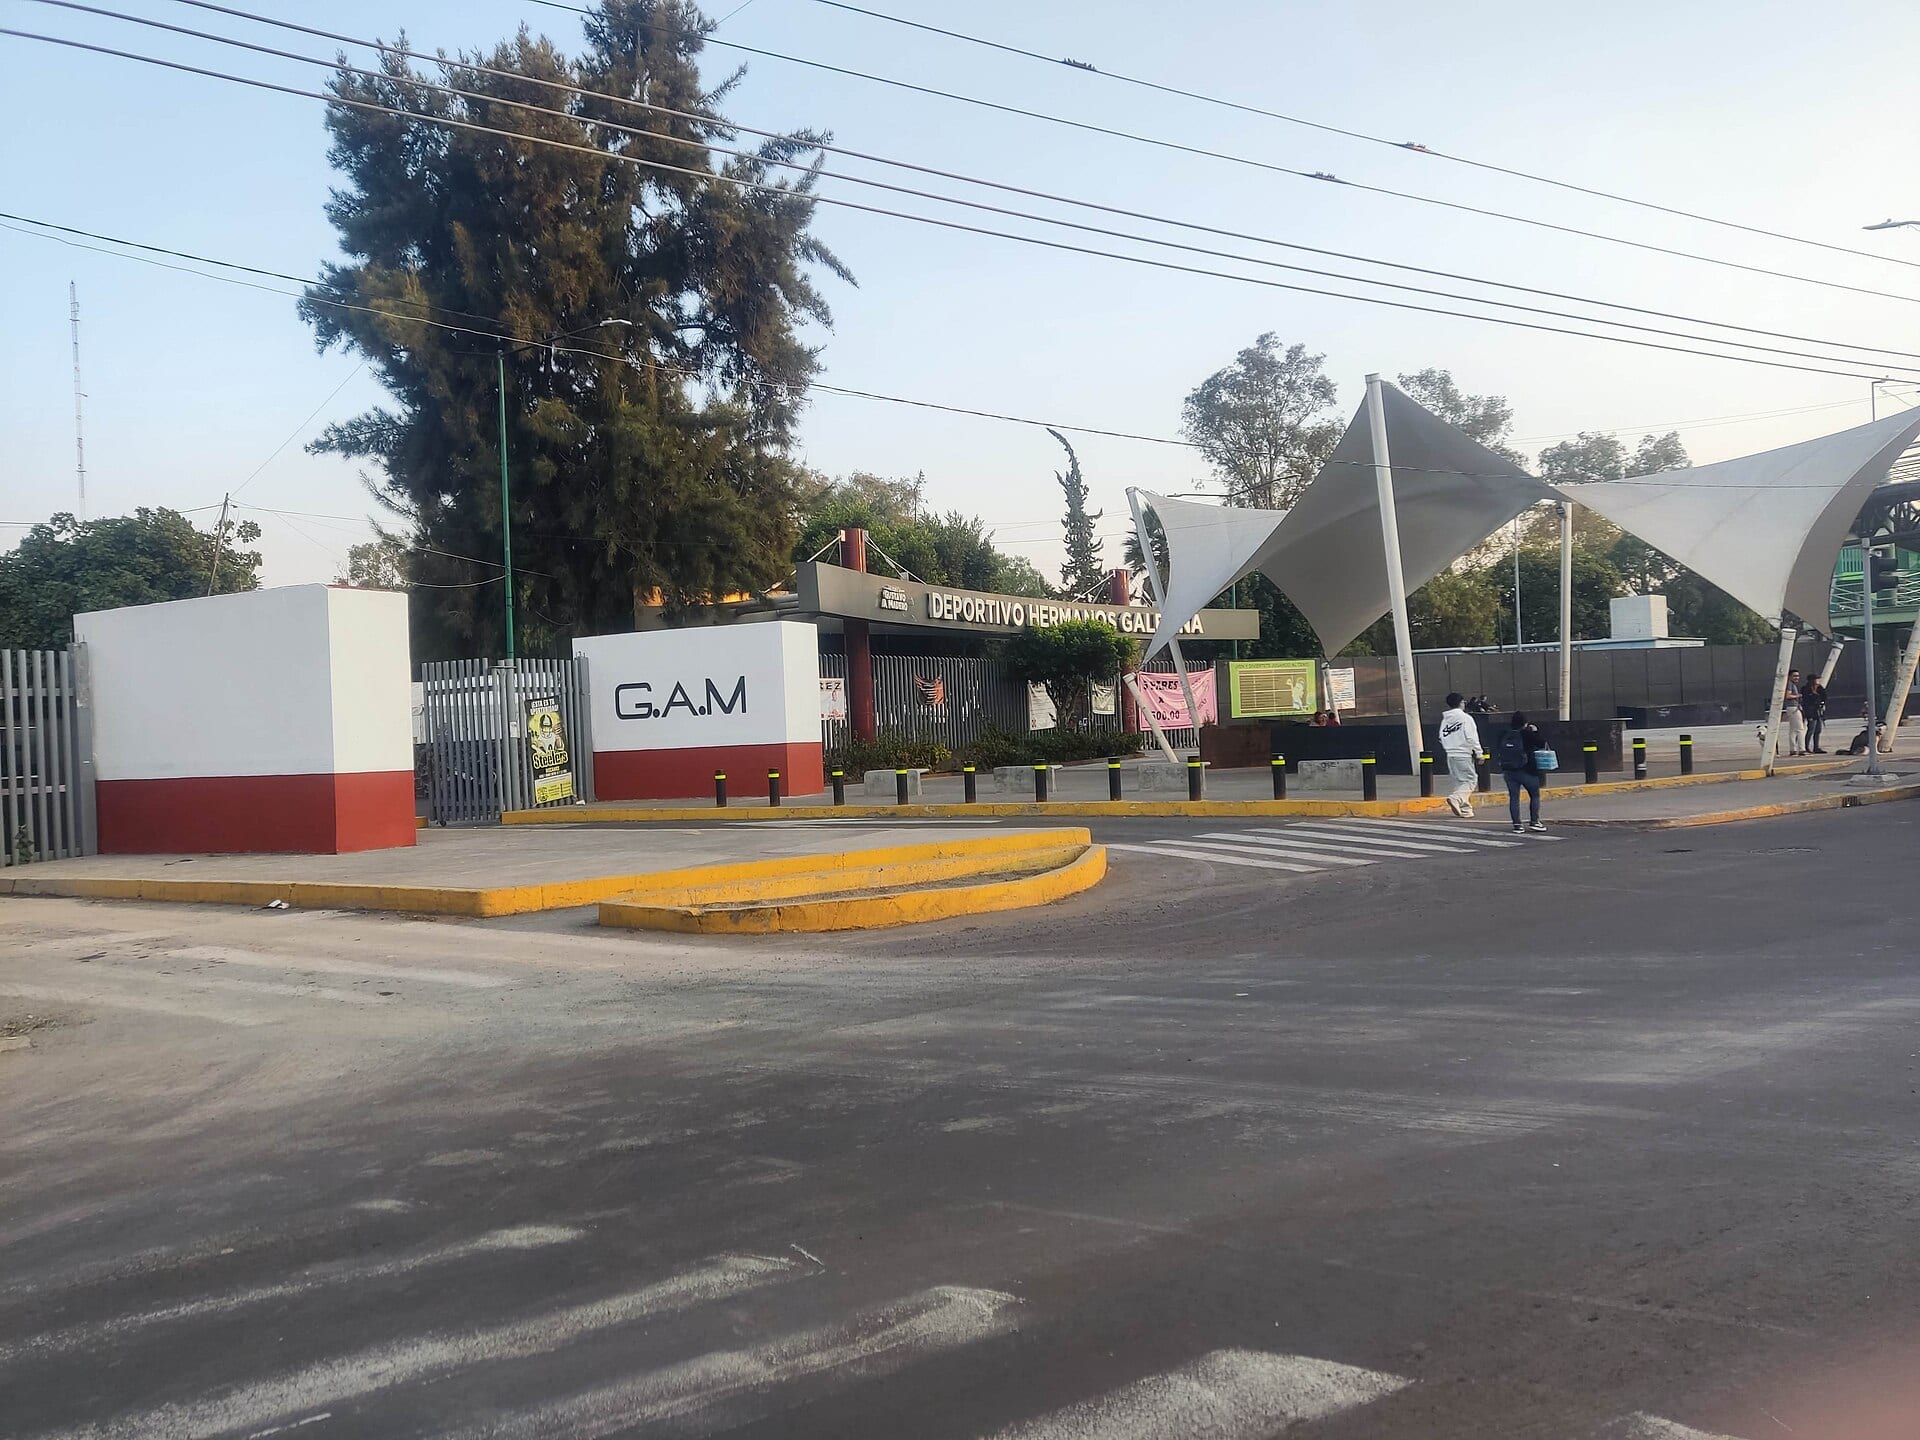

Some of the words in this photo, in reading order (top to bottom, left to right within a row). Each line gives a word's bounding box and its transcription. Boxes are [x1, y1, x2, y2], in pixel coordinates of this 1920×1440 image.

[928, 592, 1025, 627] DEPORTIVO
[1120, 611, 1204, 634] GALNA
[615, 675, 747, 720] G.A.M
[533, 750, 568, 769] Steelers
